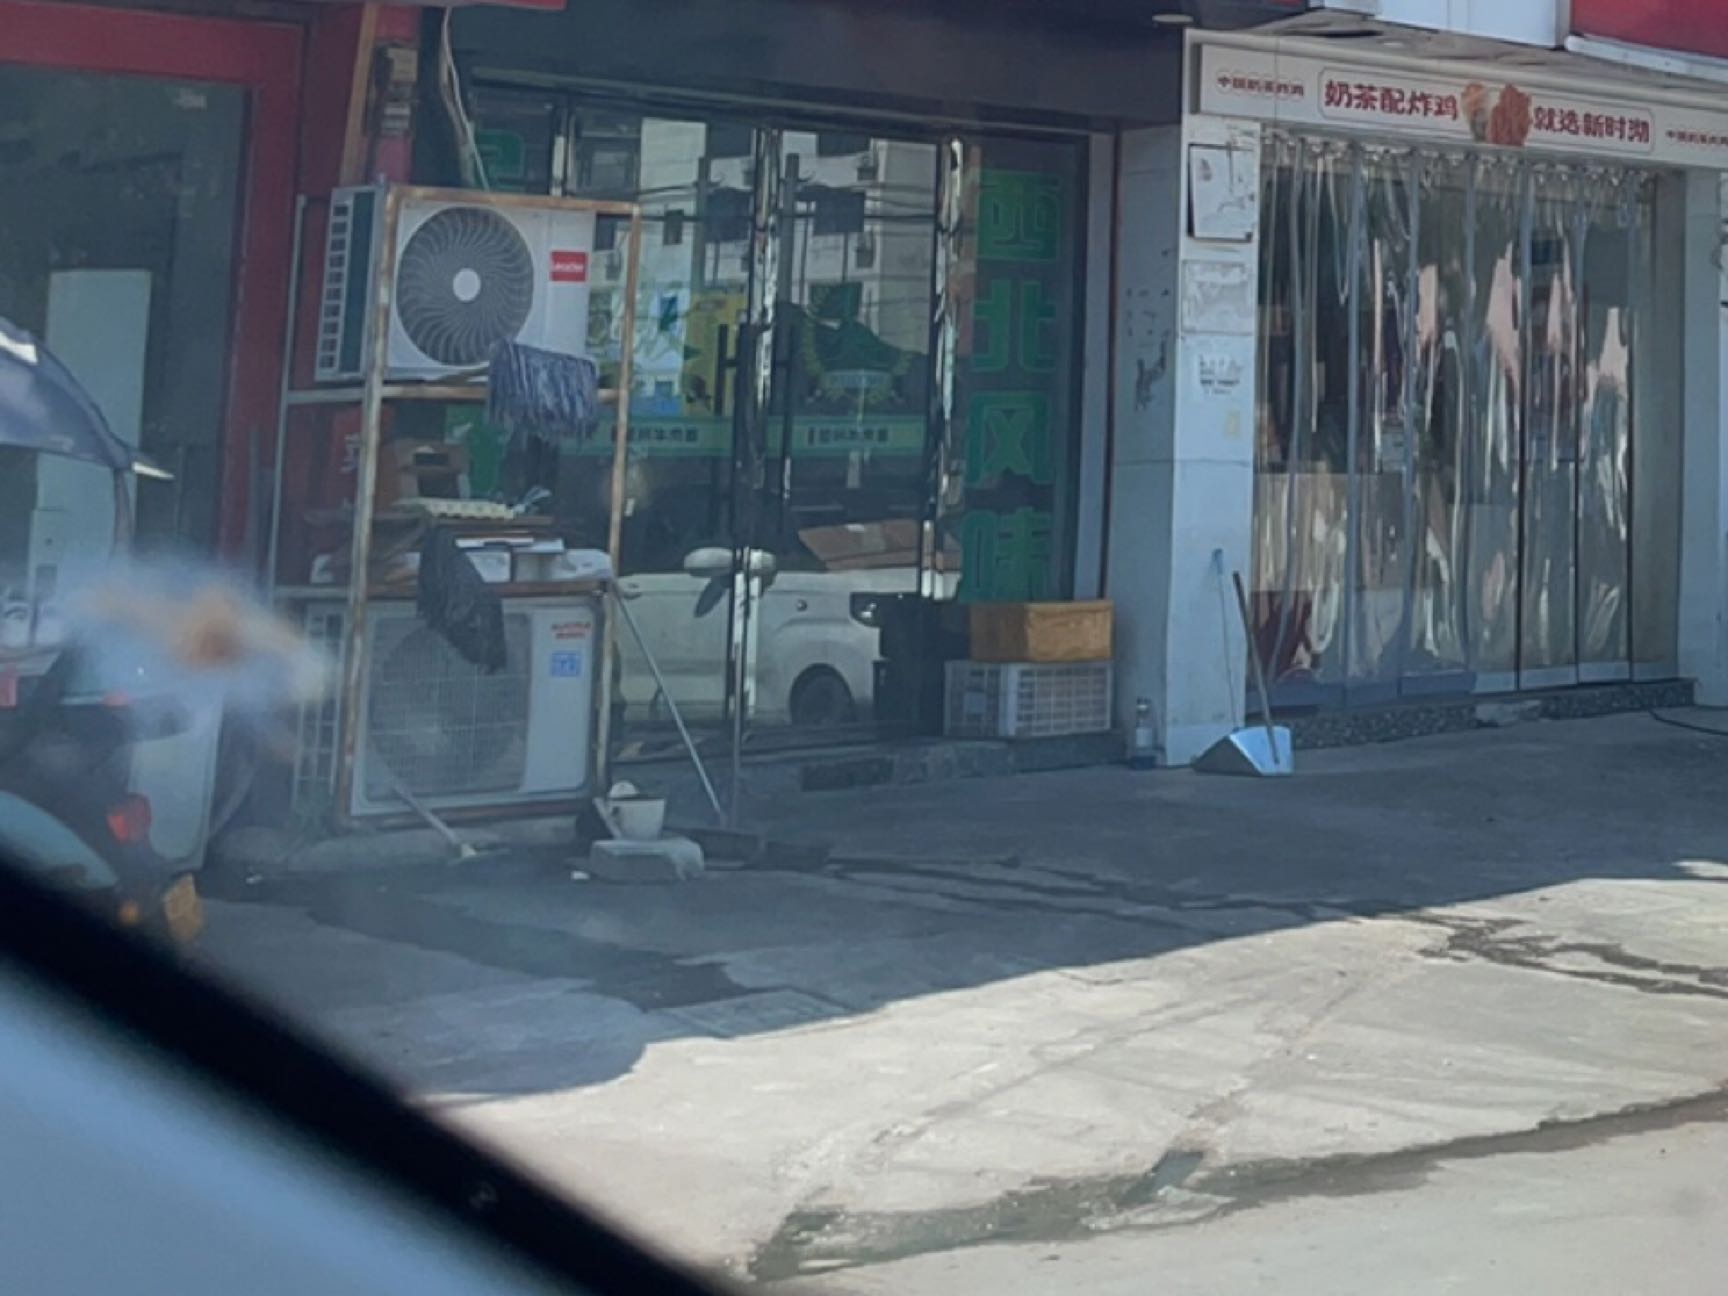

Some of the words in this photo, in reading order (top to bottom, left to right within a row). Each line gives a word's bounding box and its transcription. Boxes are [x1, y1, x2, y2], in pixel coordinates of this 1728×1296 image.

[1325, 79, 1458, 120] 奶茶配炸鸡
